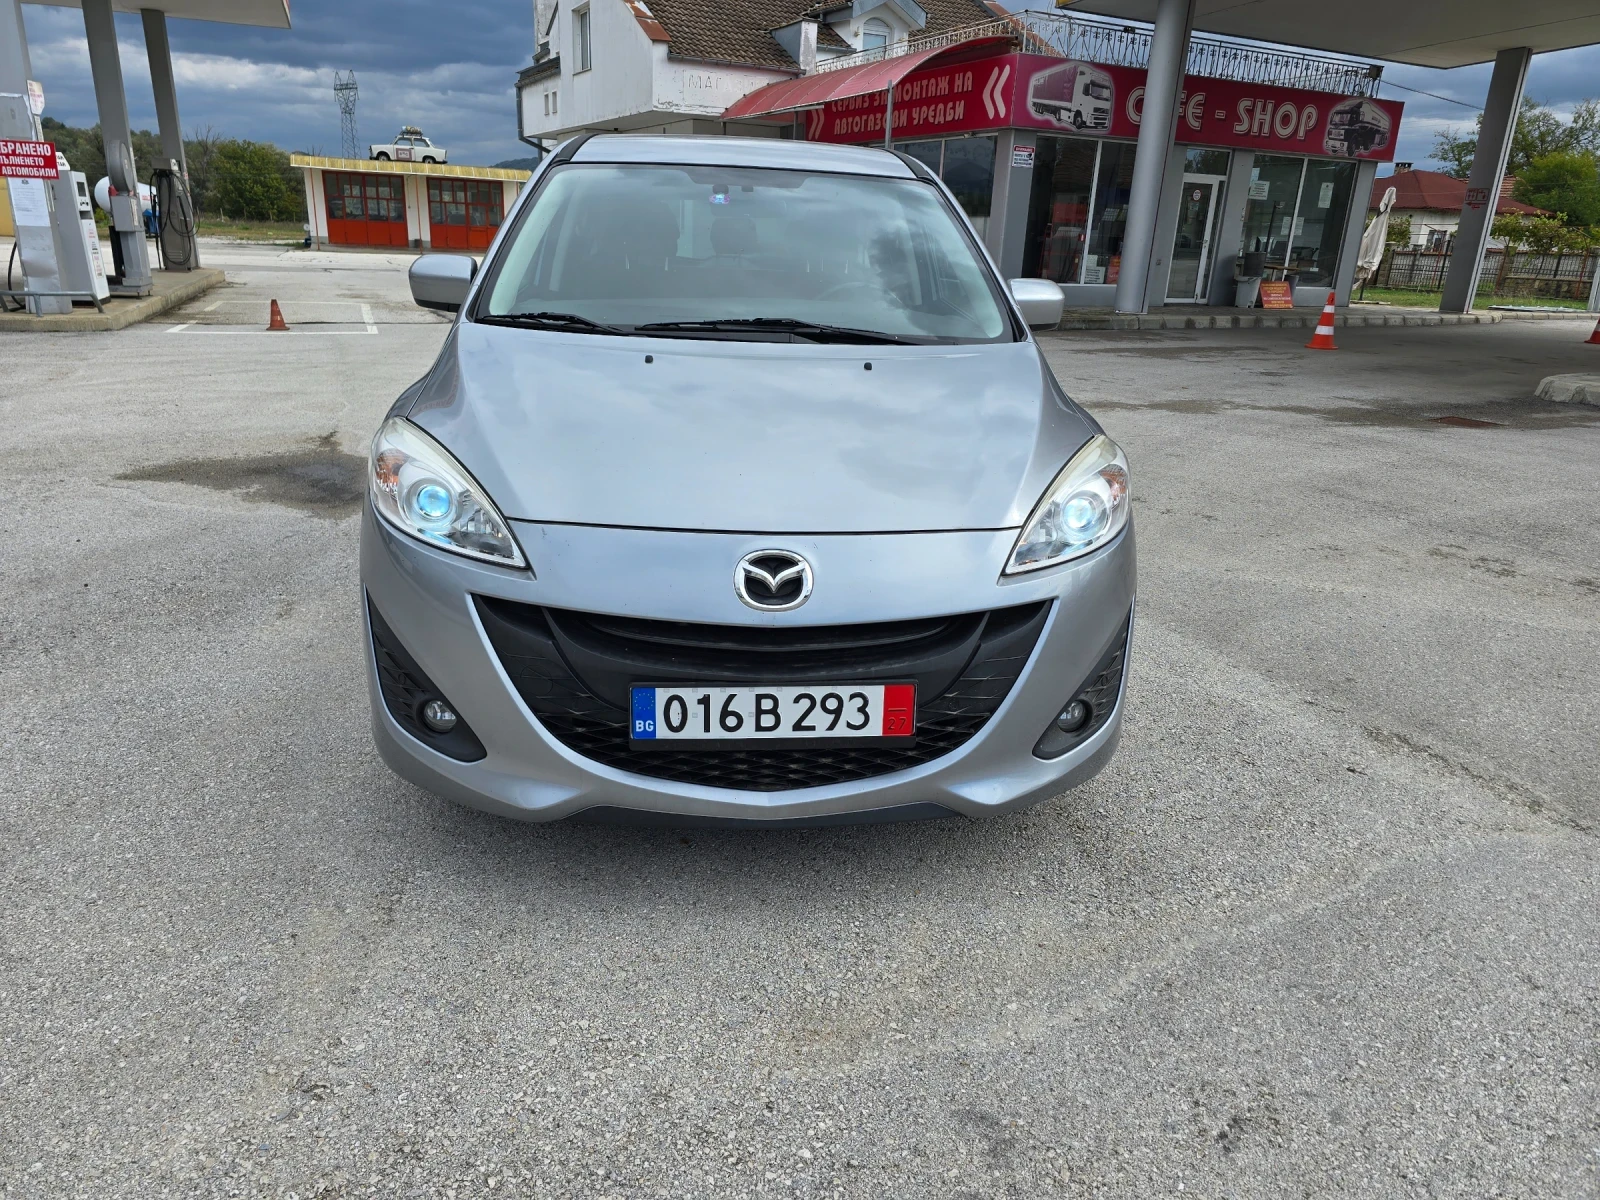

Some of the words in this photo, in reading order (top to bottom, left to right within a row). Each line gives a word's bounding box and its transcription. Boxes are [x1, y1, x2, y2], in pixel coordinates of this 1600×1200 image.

[831, 93, 870, 113] СЕРВИЗ
[892, 75, 950, 103] МОНТАЖ
[954, 71, 973, 93] НА
[911, 100, 965, 126] УРЕДБИ
[1126, 85, 1206, 131] CE
[1233, 98, 1319, 139] SHOP
[0, 141, 51, 156] БРАНЕНО
[2, 166, 57, 177] АВТОМОБИЛИ
[635, 719, 655, 732] BG
[887, 717, 907, 731] 27
